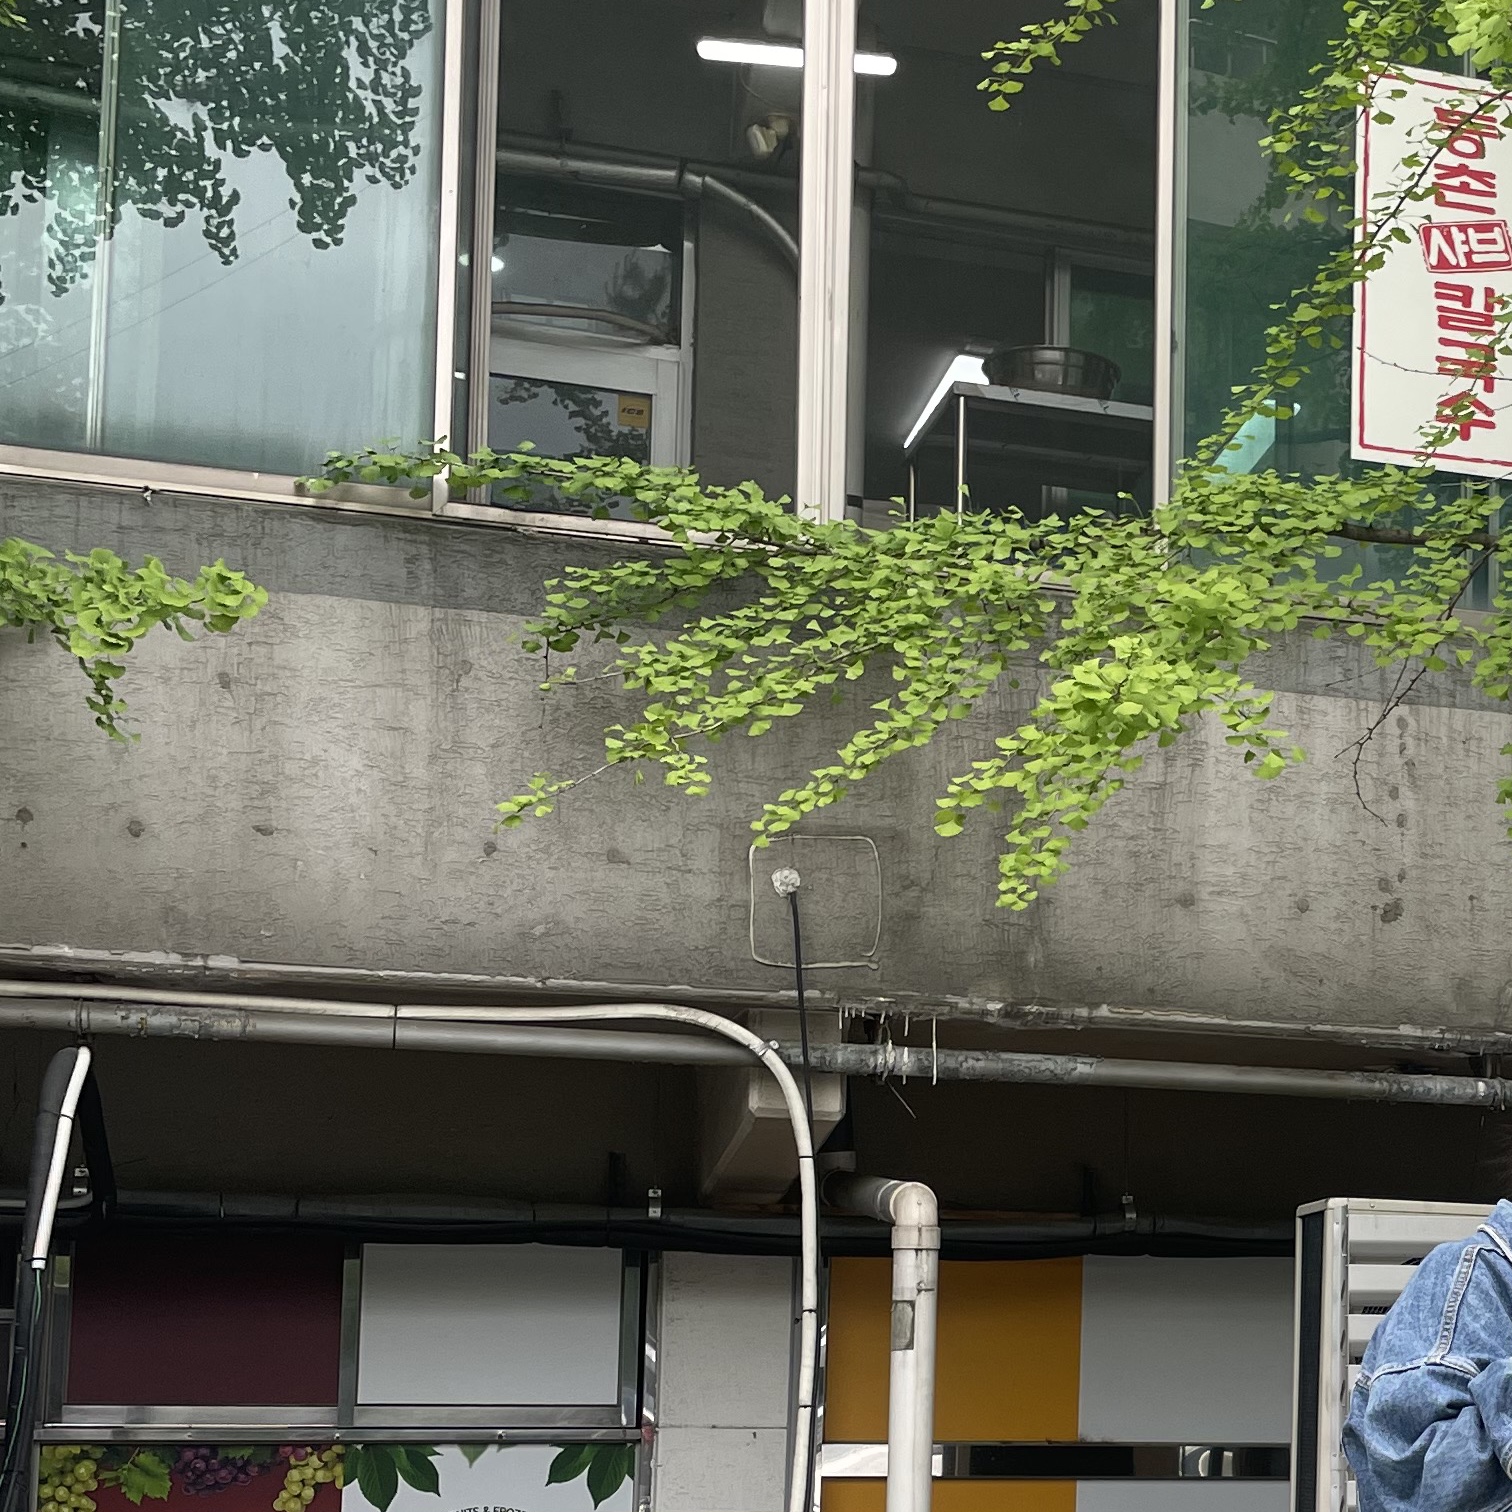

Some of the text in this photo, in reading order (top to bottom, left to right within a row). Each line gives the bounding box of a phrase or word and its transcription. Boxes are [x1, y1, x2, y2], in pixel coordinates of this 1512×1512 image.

[1428, 106, 1512, 442] 등촌 샤브 칼국수
